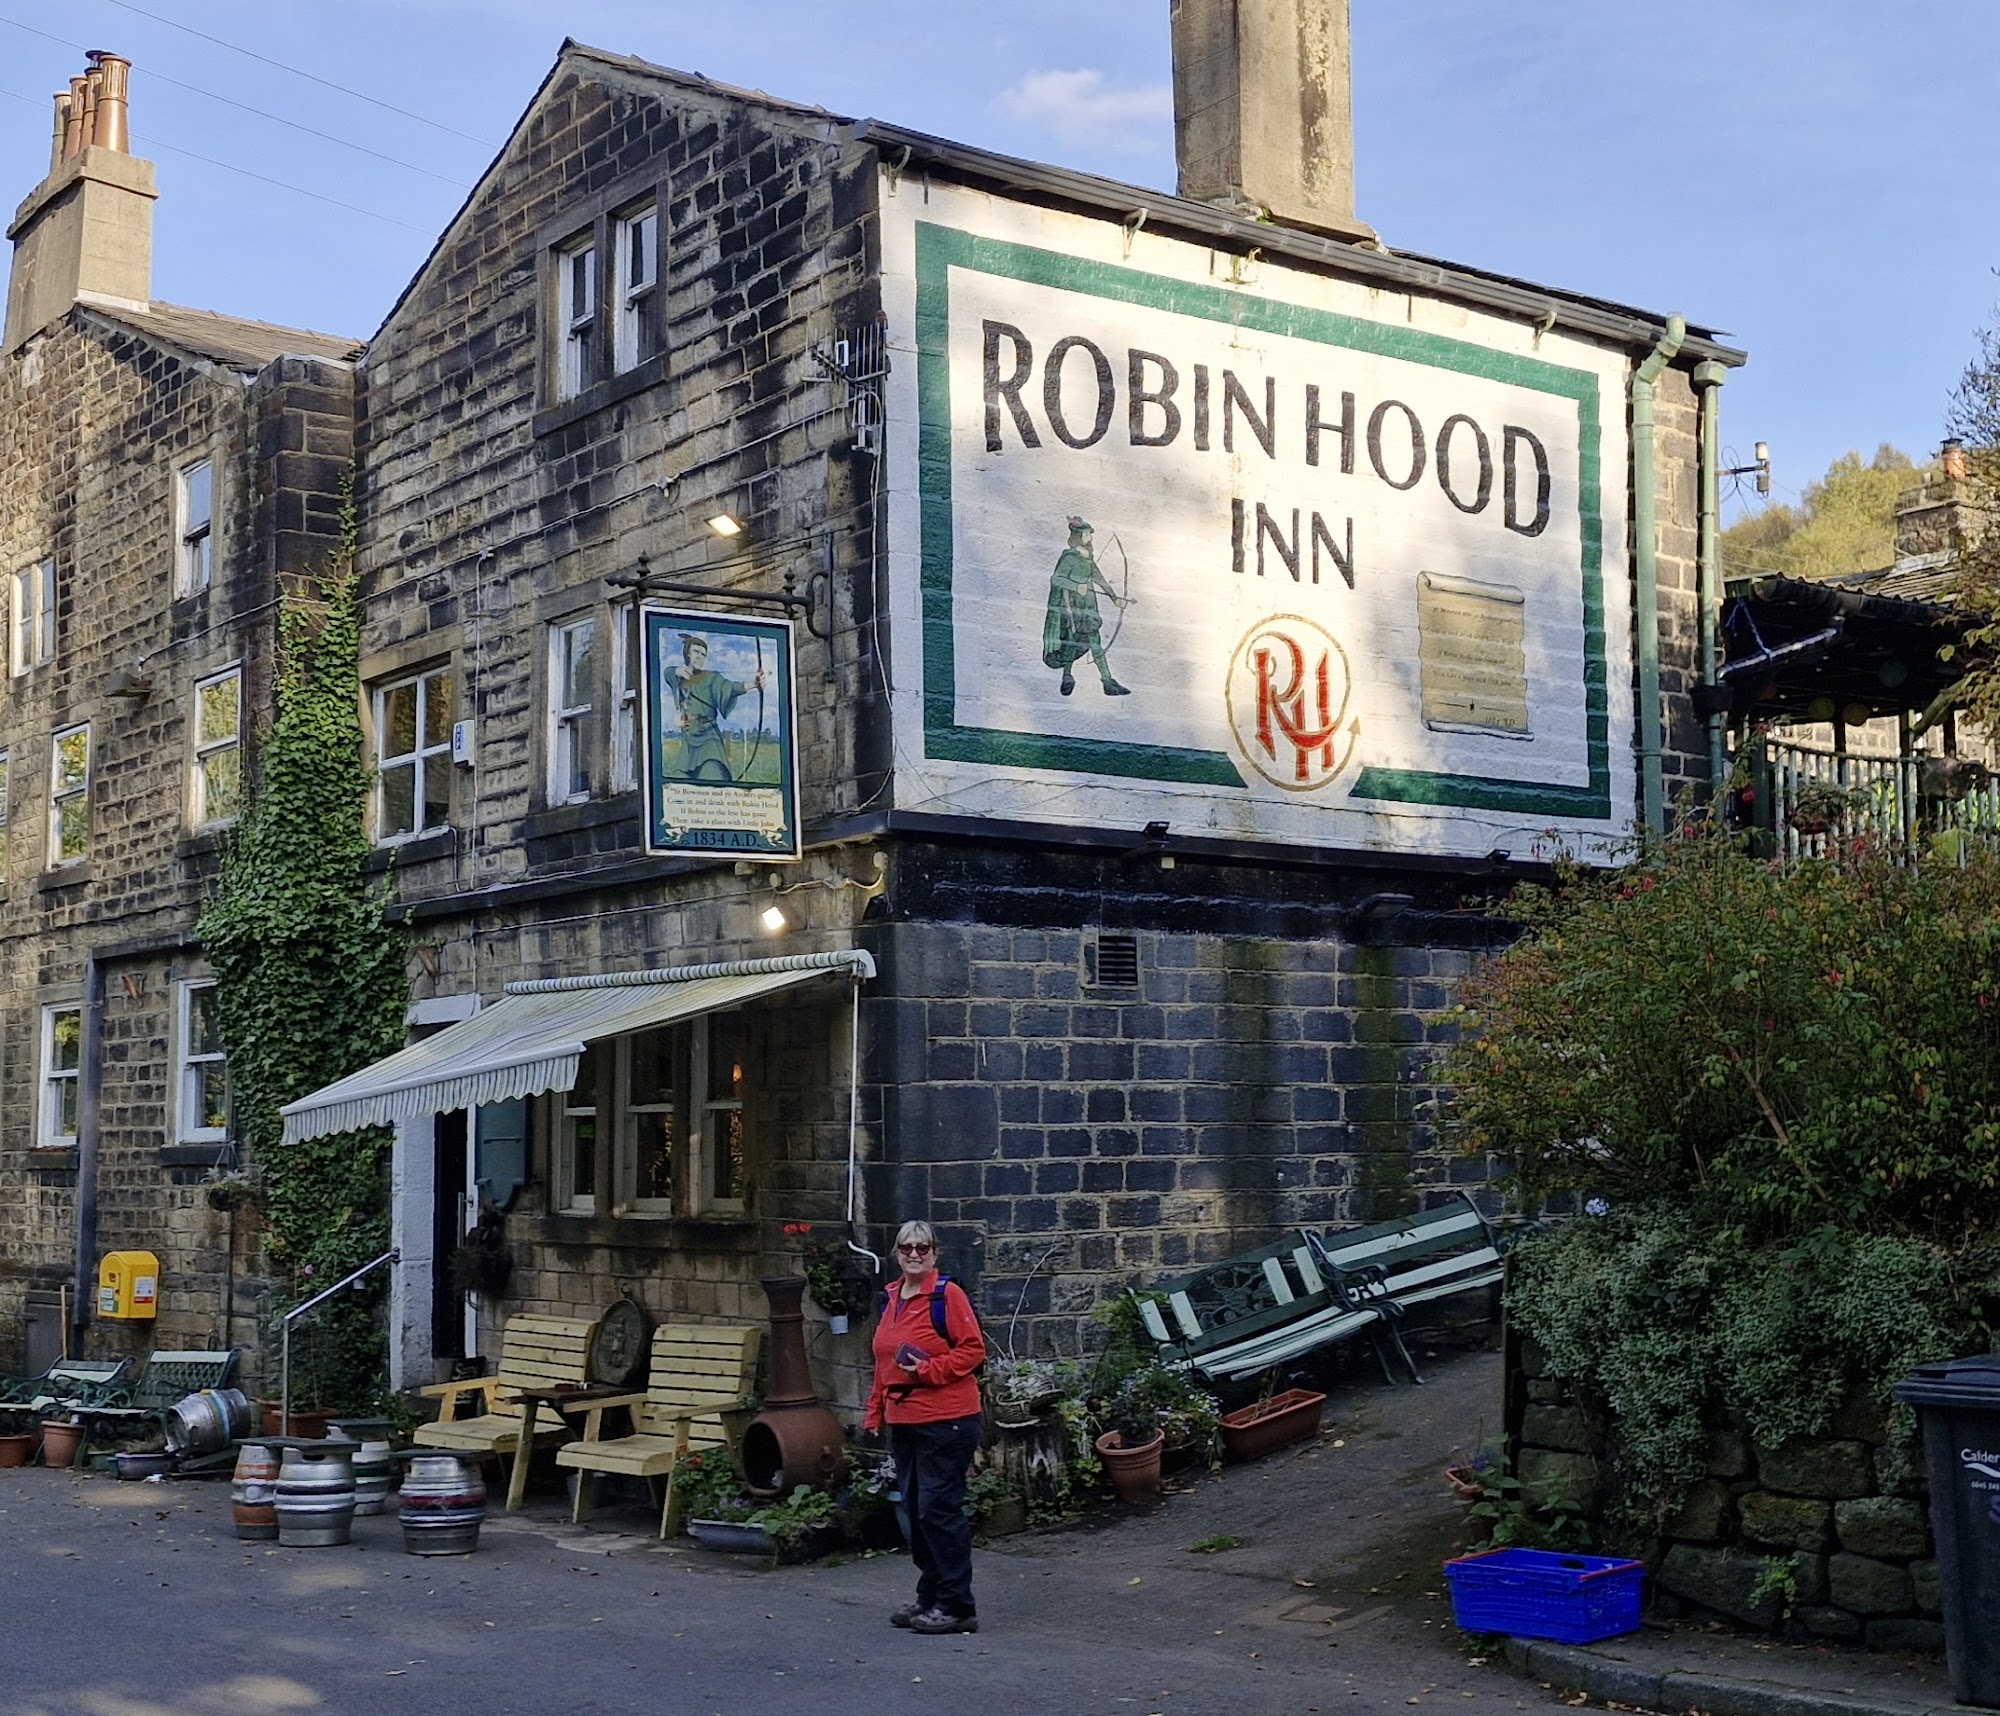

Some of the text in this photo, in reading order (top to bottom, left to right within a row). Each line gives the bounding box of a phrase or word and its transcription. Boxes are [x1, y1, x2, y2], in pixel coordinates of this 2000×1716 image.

[982, 319, 1551, 537] ROBIN HOOD
[1232, 498, 1355, 590] INN
[693, 831, 725, 846] 1834
